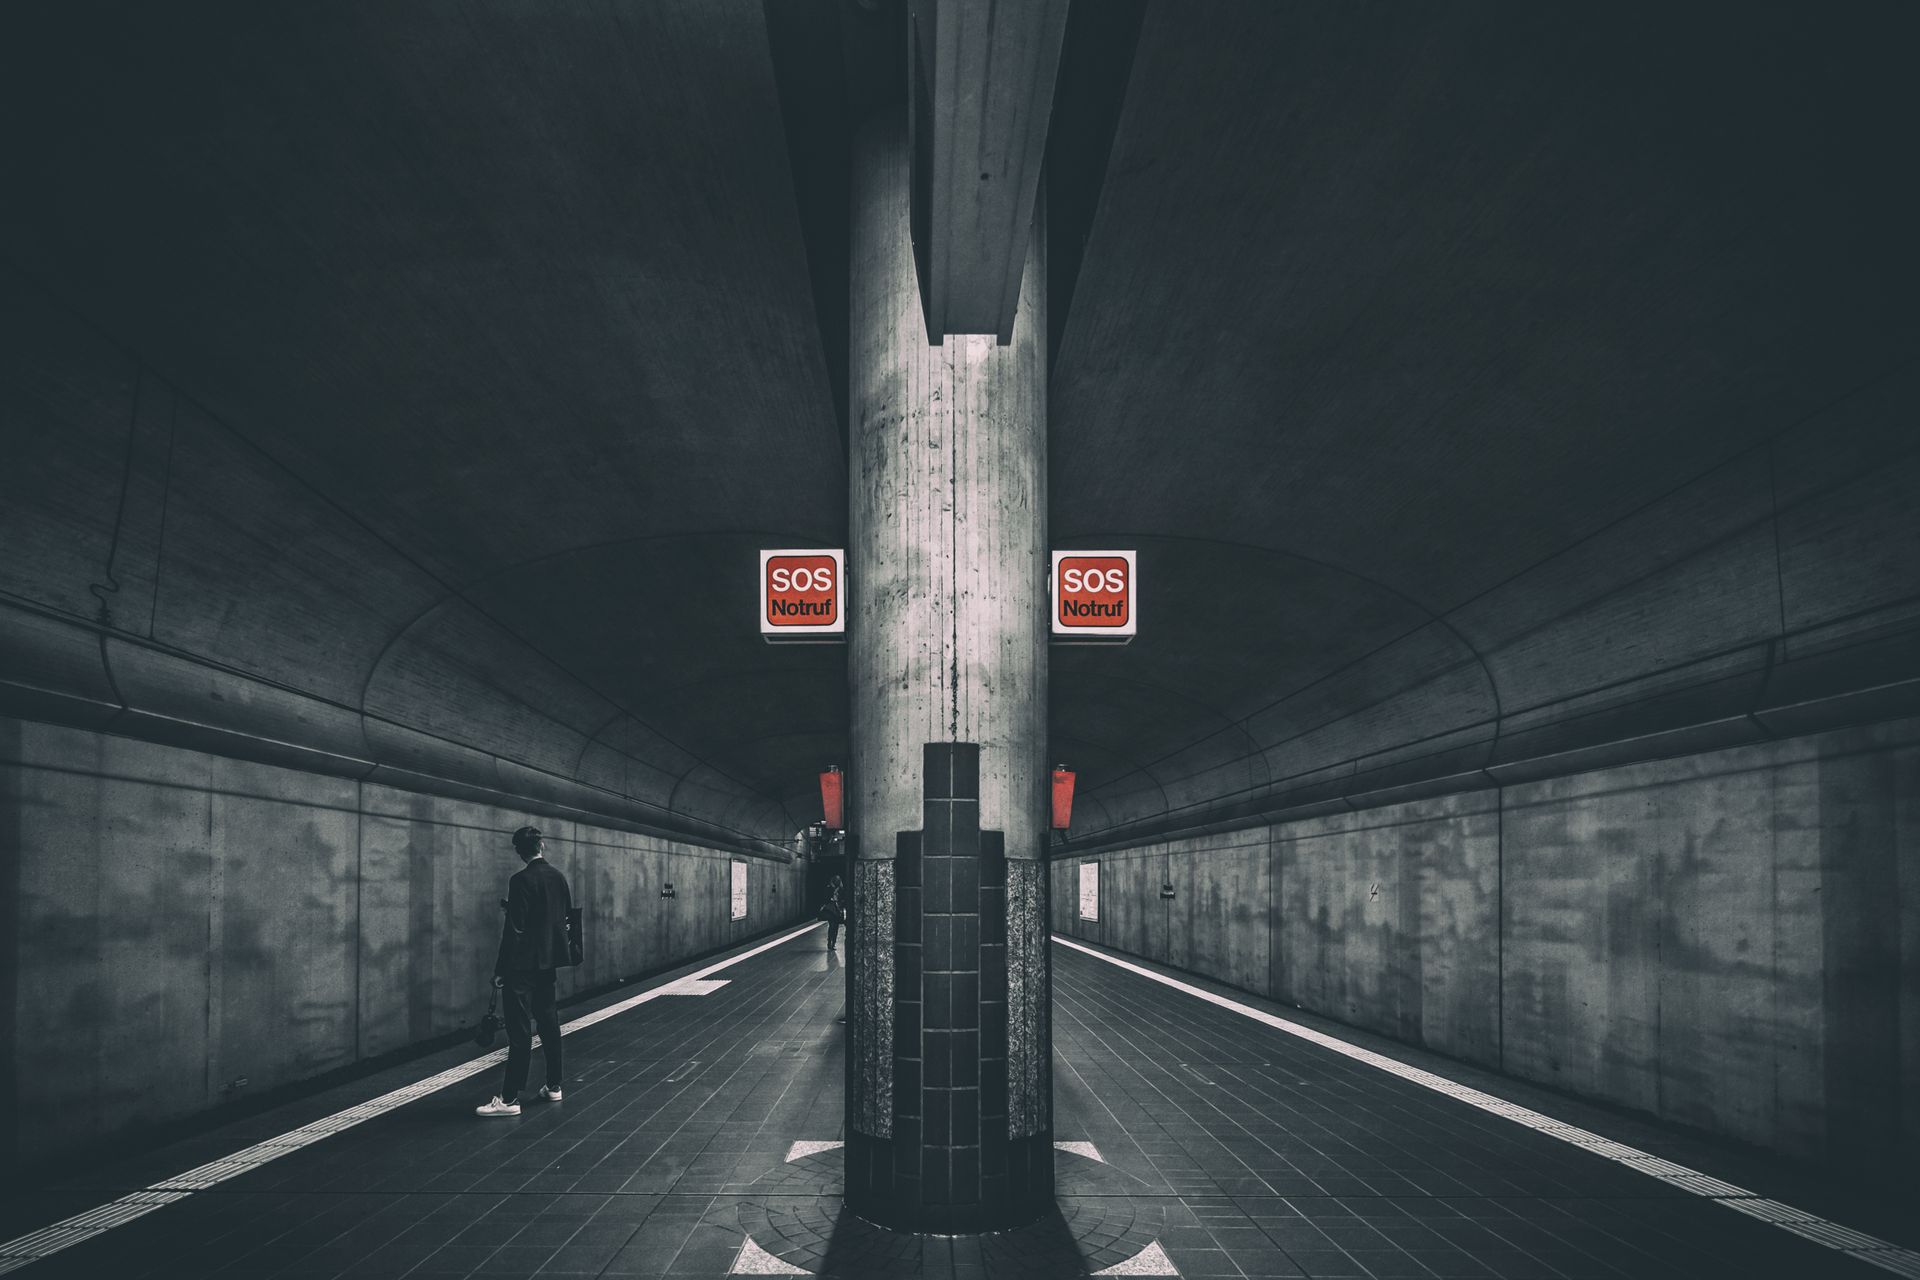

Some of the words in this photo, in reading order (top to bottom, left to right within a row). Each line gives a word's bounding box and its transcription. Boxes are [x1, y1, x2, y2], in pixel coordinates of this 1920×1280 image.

[771, 567, 832, 592] SOS
[1063, 568, 1124, 593] SOS
[771, 599, 831, 616] Notruf
[1063, 599, 1124, 617] Notruf
